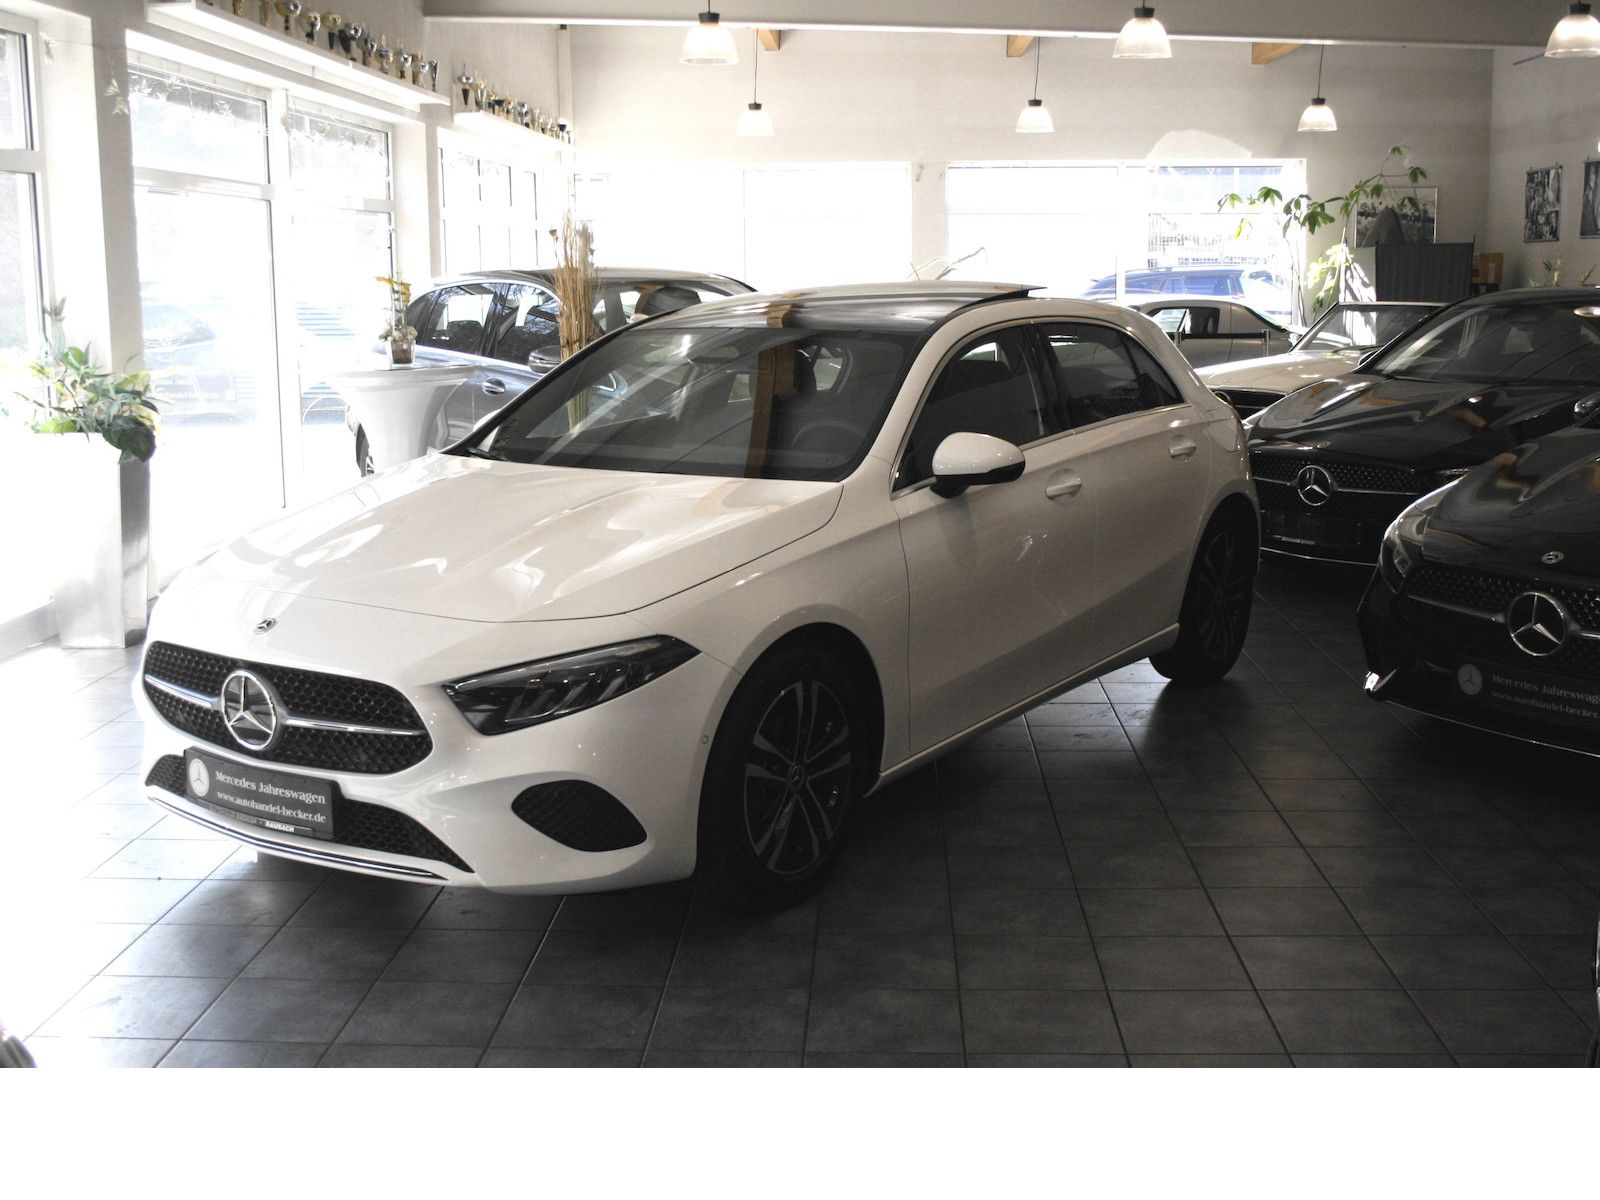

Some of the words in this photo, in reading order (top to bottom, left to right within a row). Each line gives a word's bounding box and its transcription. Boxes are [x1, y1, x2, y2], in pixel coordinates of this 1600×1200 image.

[1491, 673, 1539, 692] Mercedes
[1542, 684, 1600, 704] Jahreswag
[216, 771, 256, 790] Mercedes
[258, 780, 326, 804] Jahreswagen
[217, 792, 327, 823] www.autohandel-becker.de
